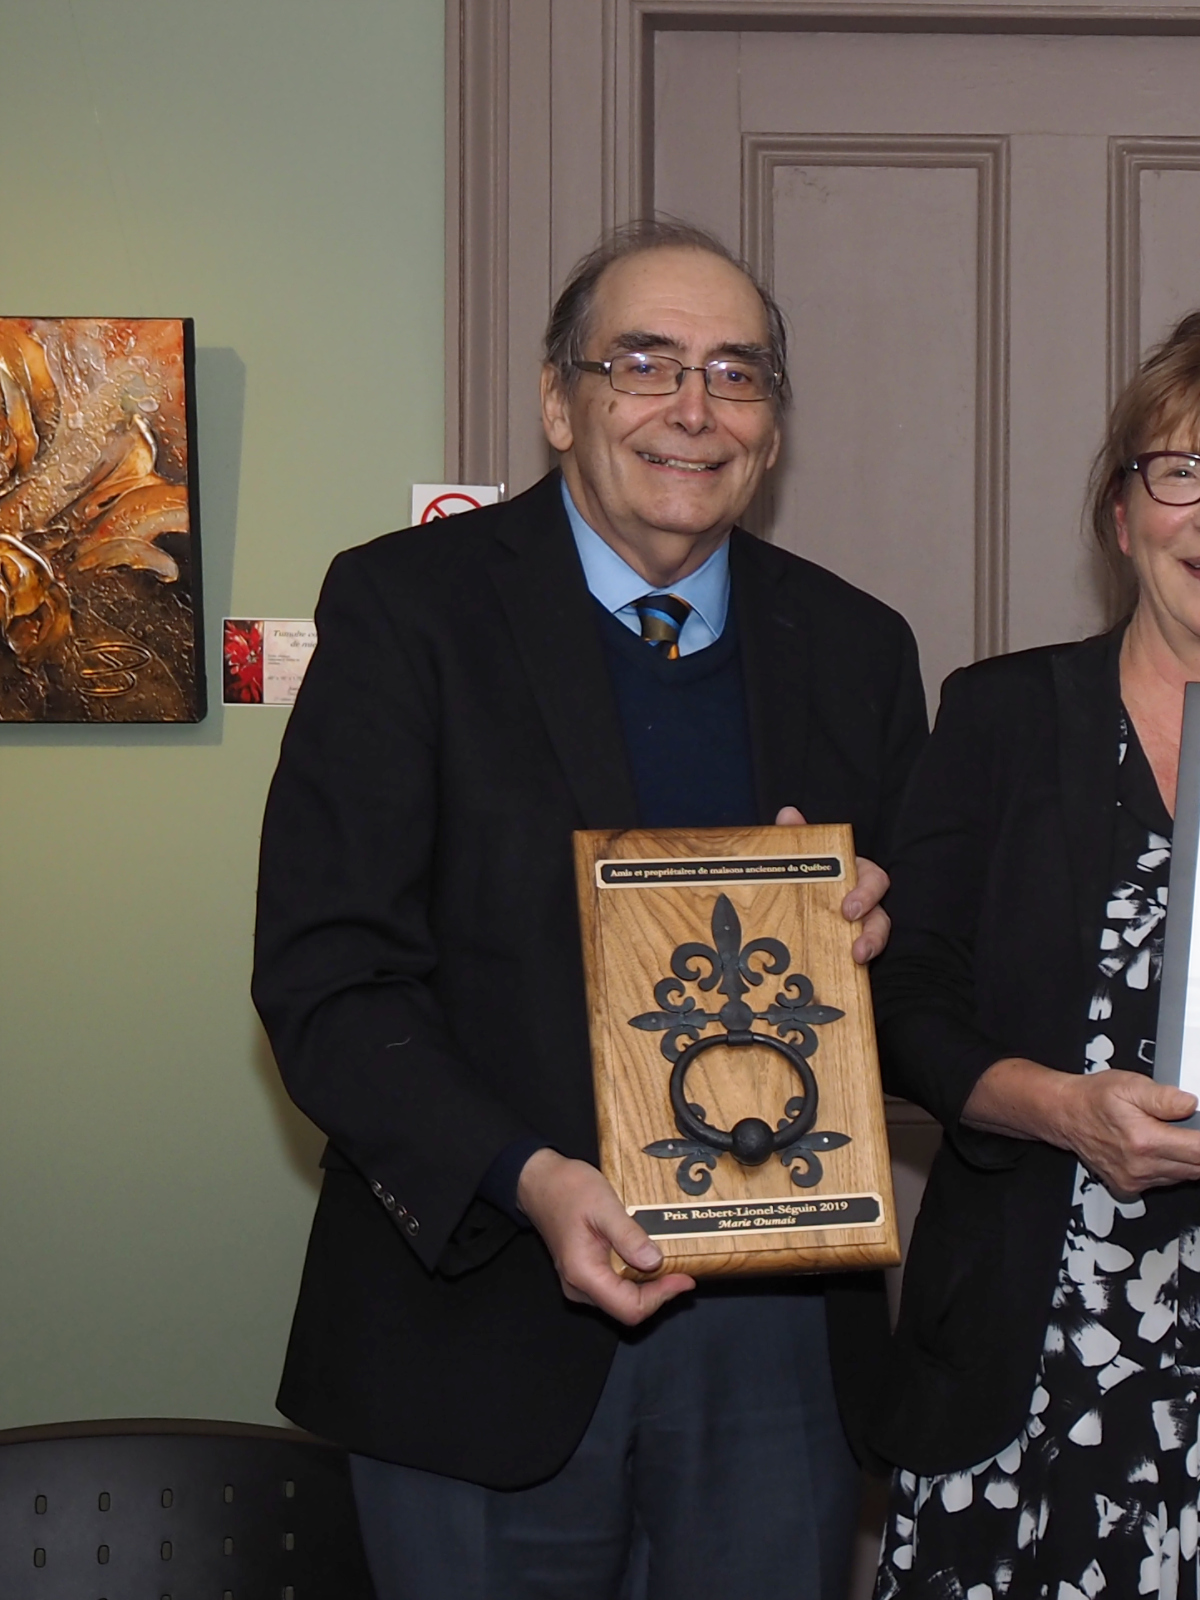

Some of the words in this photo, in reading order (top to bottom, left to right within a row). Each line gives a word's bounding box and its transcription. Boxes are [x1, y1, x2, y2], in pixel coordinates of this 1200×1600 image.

[610, 869, 632, 877] Amis
[644, 867, 696, 878] propriétaires
[710, 866, 744, 874] maisons
[745, 865, 786, 874] anciennes
[787, 864, 798, 872] du
[800, 863, 832, 873] Québec
[663, 1211, 689, 1221] Prix
[692, 1203, 817, 1220] Robert-Lionel-Séguin
[820, 1201, 849, 1212] 2019
[718, 1218, 752, 1229] Marie
[753, 1216, 797, 1227] Dumais
